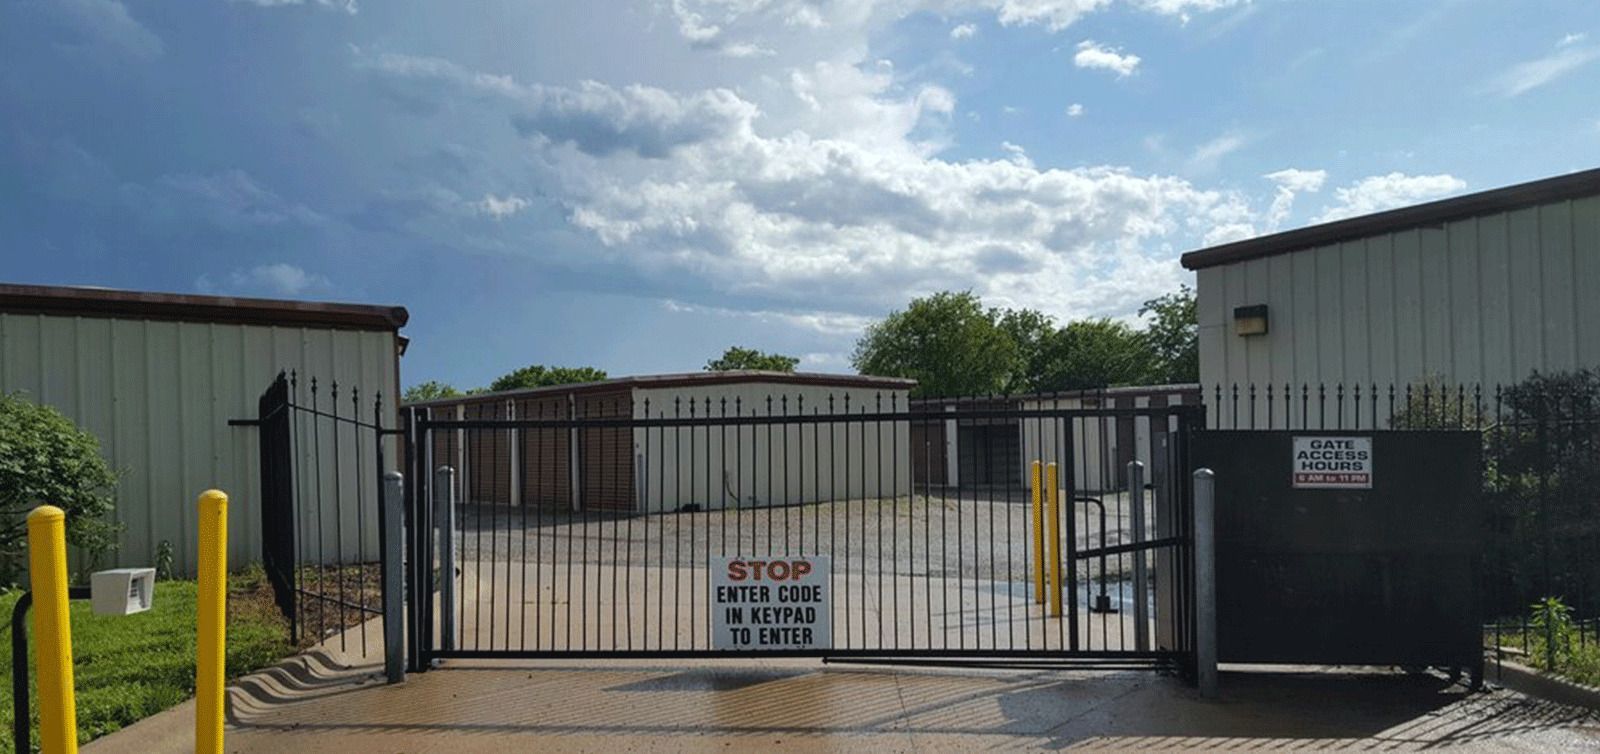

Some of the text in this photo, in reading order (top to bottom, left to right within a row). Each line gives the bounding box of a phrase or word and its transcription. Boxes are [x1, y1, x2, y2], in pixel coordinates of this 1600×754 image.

[1310, 440, 1354, 450] GATE
[1297, 450, 1368, 460] ACCESS
[1302, 461, 1363, 471] HOURS
[728, 560, 812, 581] STOP
[717, 585, 822, 603] ENTER CODE
[726, 607, 816, 624] IN KEYPAD
[730, 628, 813, 645] TO ENTER
